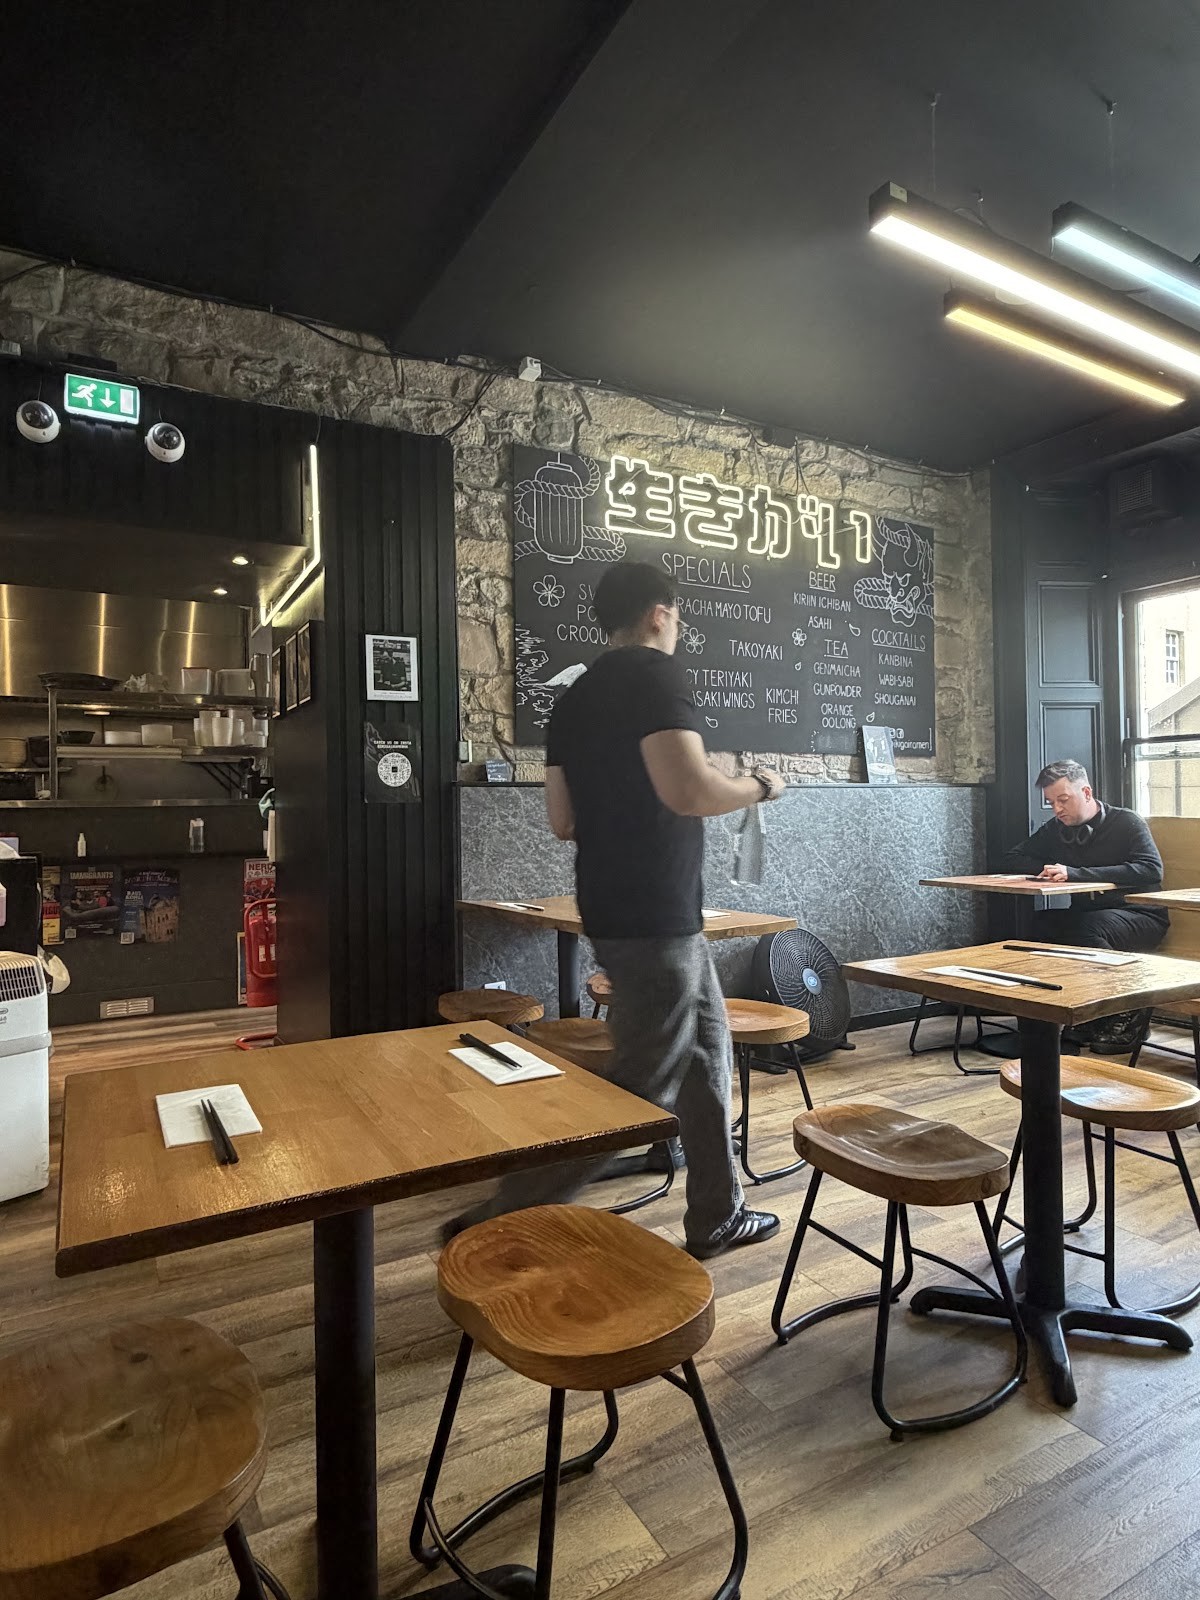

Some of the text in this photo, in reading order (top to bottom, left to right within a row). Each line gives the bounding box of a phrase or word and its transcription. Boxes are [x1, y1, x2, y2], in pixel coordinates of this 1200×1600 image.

[661, 552, 752, 589] SPECIALS
[808, 570, 836, 591] BEER
[676, 595, 771, 624] RACHA MAYO TOFU
[818, 596, 851, 613] ICHIBAN
[807, 615, 832, 630] ASAHI
[824, 639, 849, 656] TEA
[871, 628, 926, 650] COCKTAILS
[729, 639, 783, 661] TAKOYAKI
[878, 652, 913, 668] KANBINA
[813, 661, 861, 678] GENMAICHA
[702, 669, 753, 688] TERIYAKI
[878, 673, 914, 688] WABI-SABI
[765, 688, 799, 705] KIMCHI
[813, 682, 862, 698] GUNPOWDER
[722, 691, 755, 709] WINGS
[874, 692, 917, 706] SHOUGANAI
[768, 707, 798, 724] FRIES
[820, 702, 854, 717] ORANGE
[821, 717, 857, 729] OOLONG
